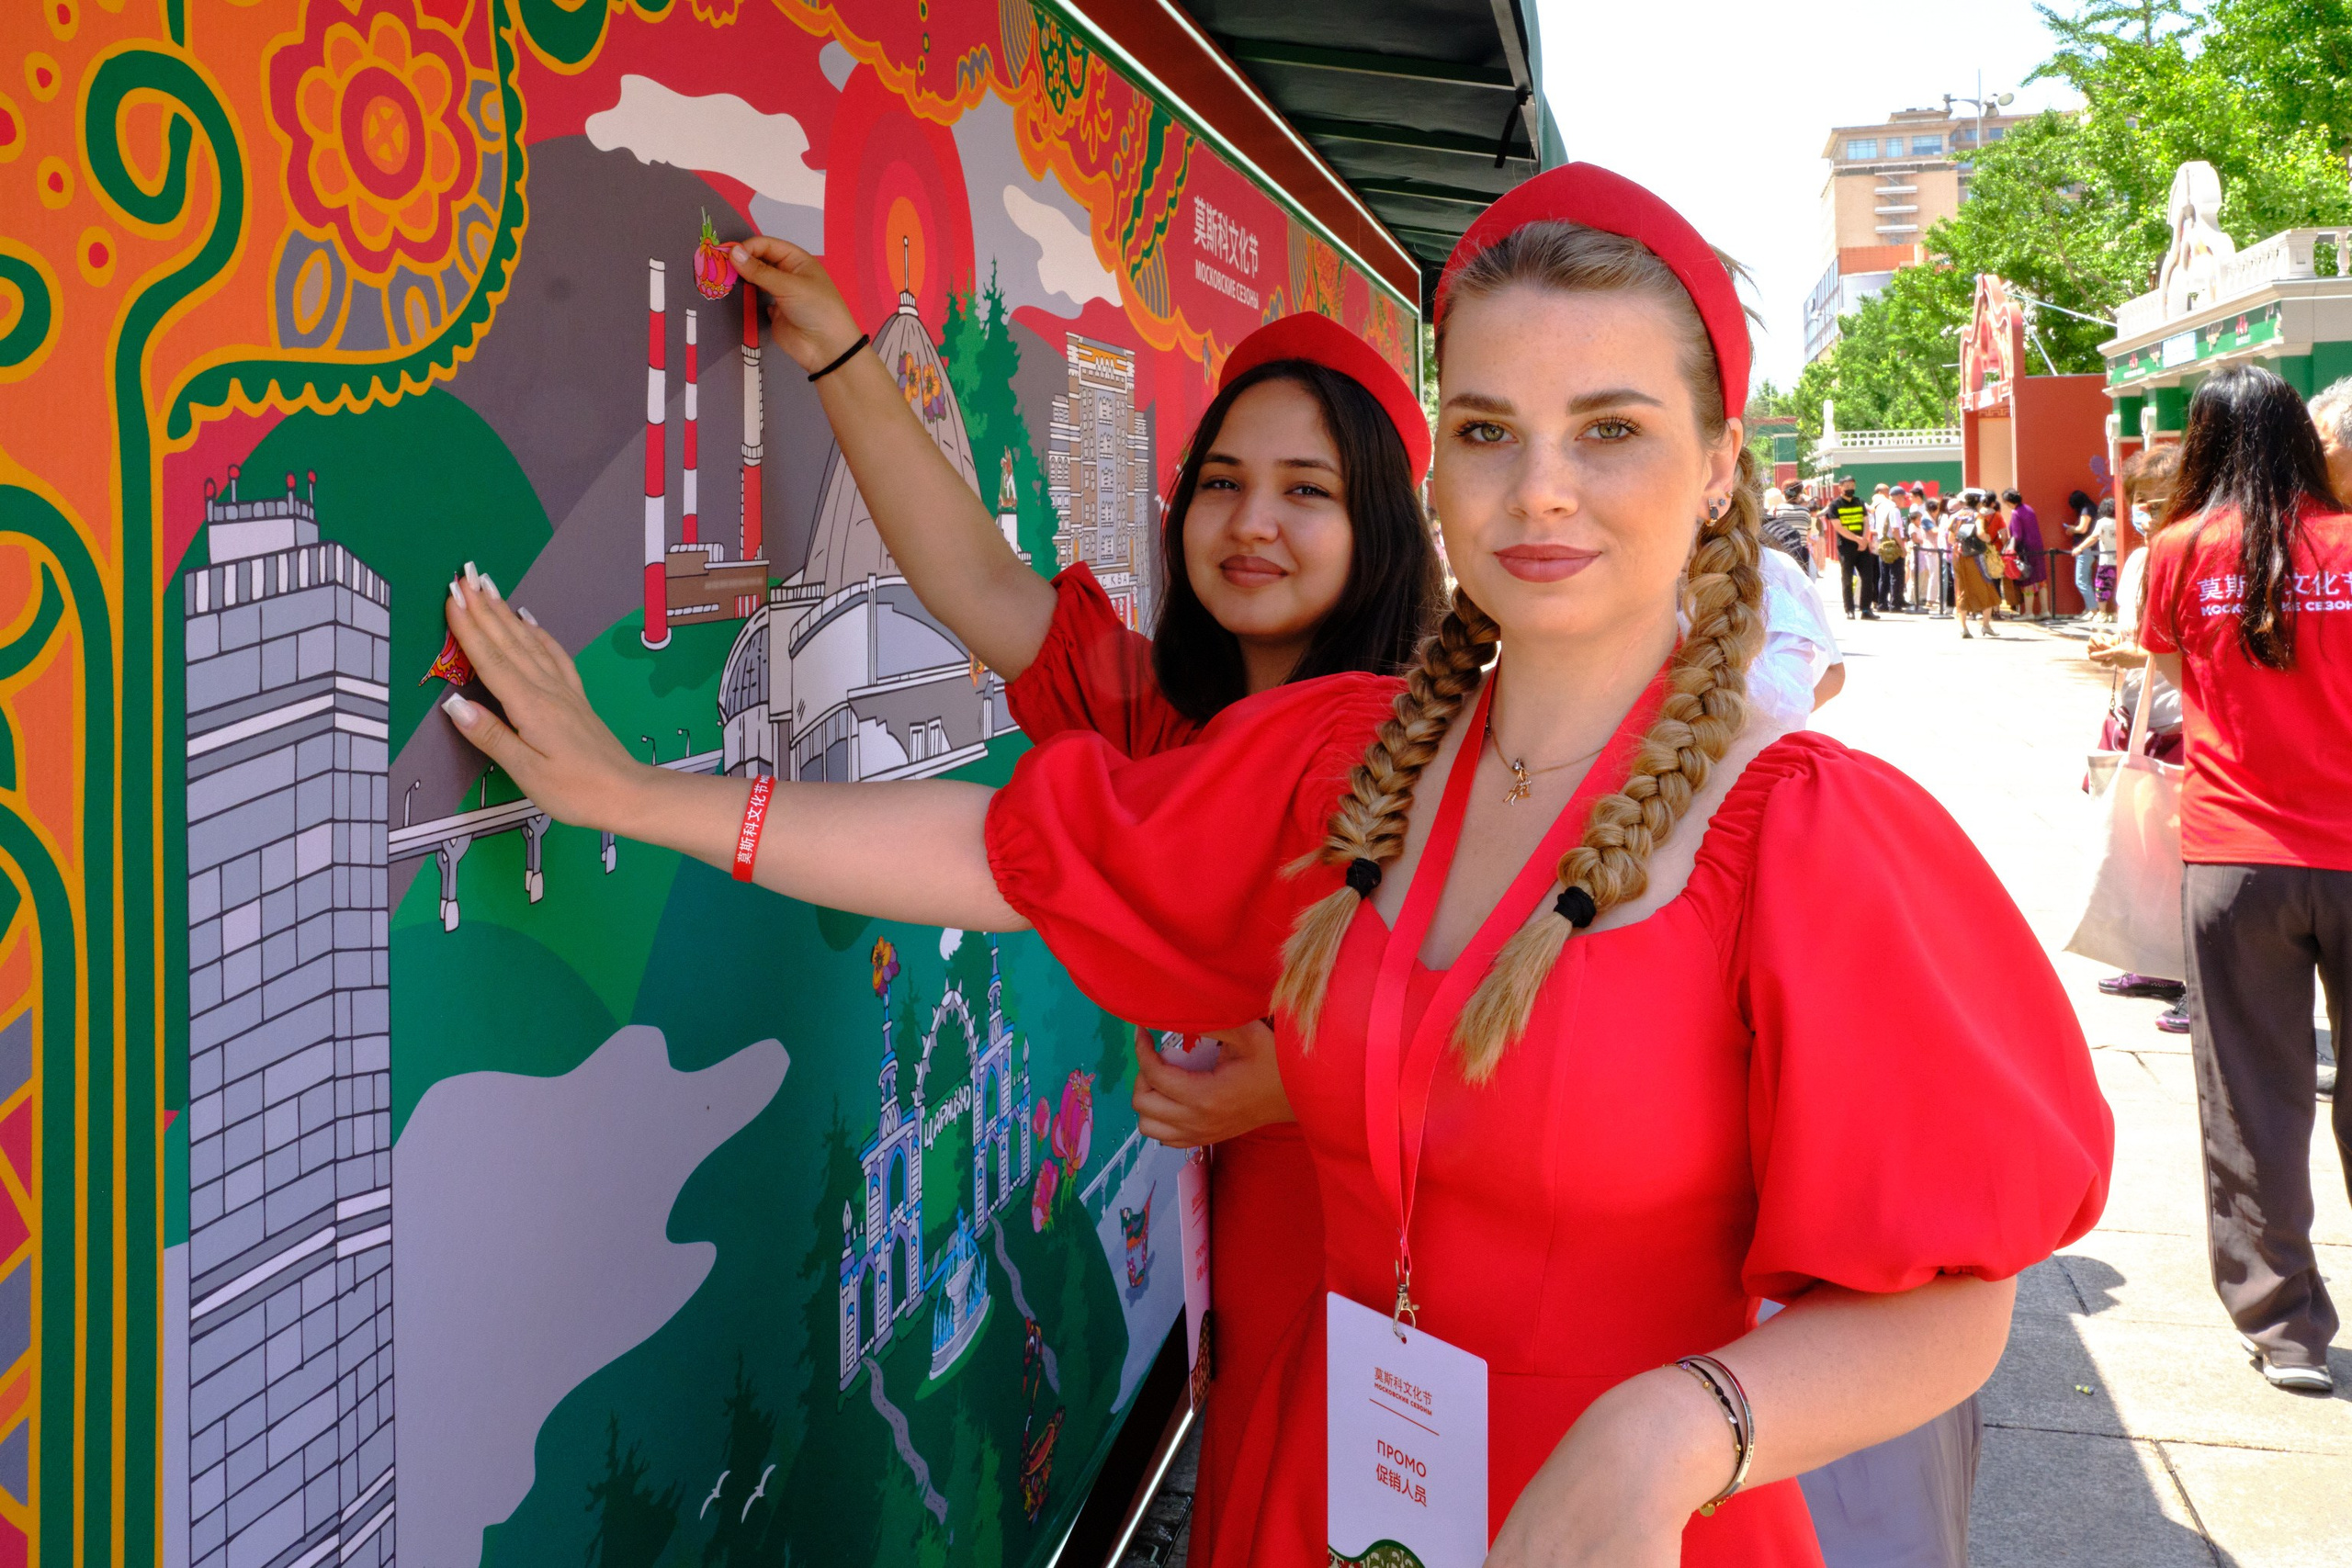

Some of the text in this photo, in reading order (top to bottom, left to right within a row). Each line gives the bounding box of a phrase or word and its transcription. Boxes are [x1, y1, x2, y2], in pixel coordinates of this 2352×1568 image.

[1194, 196, 1259, 278] 莫斯科文化节
[1195, 259, 1259, 310] МОСКОВСКИЕ СЕЗОНЫ
[737, 784, 769, 864] 莫斯科文化节
[1374, 1367, 1432, 1405] 莫斯科文化节
[1374, 1382, 1432, 1416] МОСКОВСКИЕ СЕЗОНЫ
[1377, 1439, 1427, 1478] ПРОМО
[1376, 1463, 1427, 1506] 促销人员
